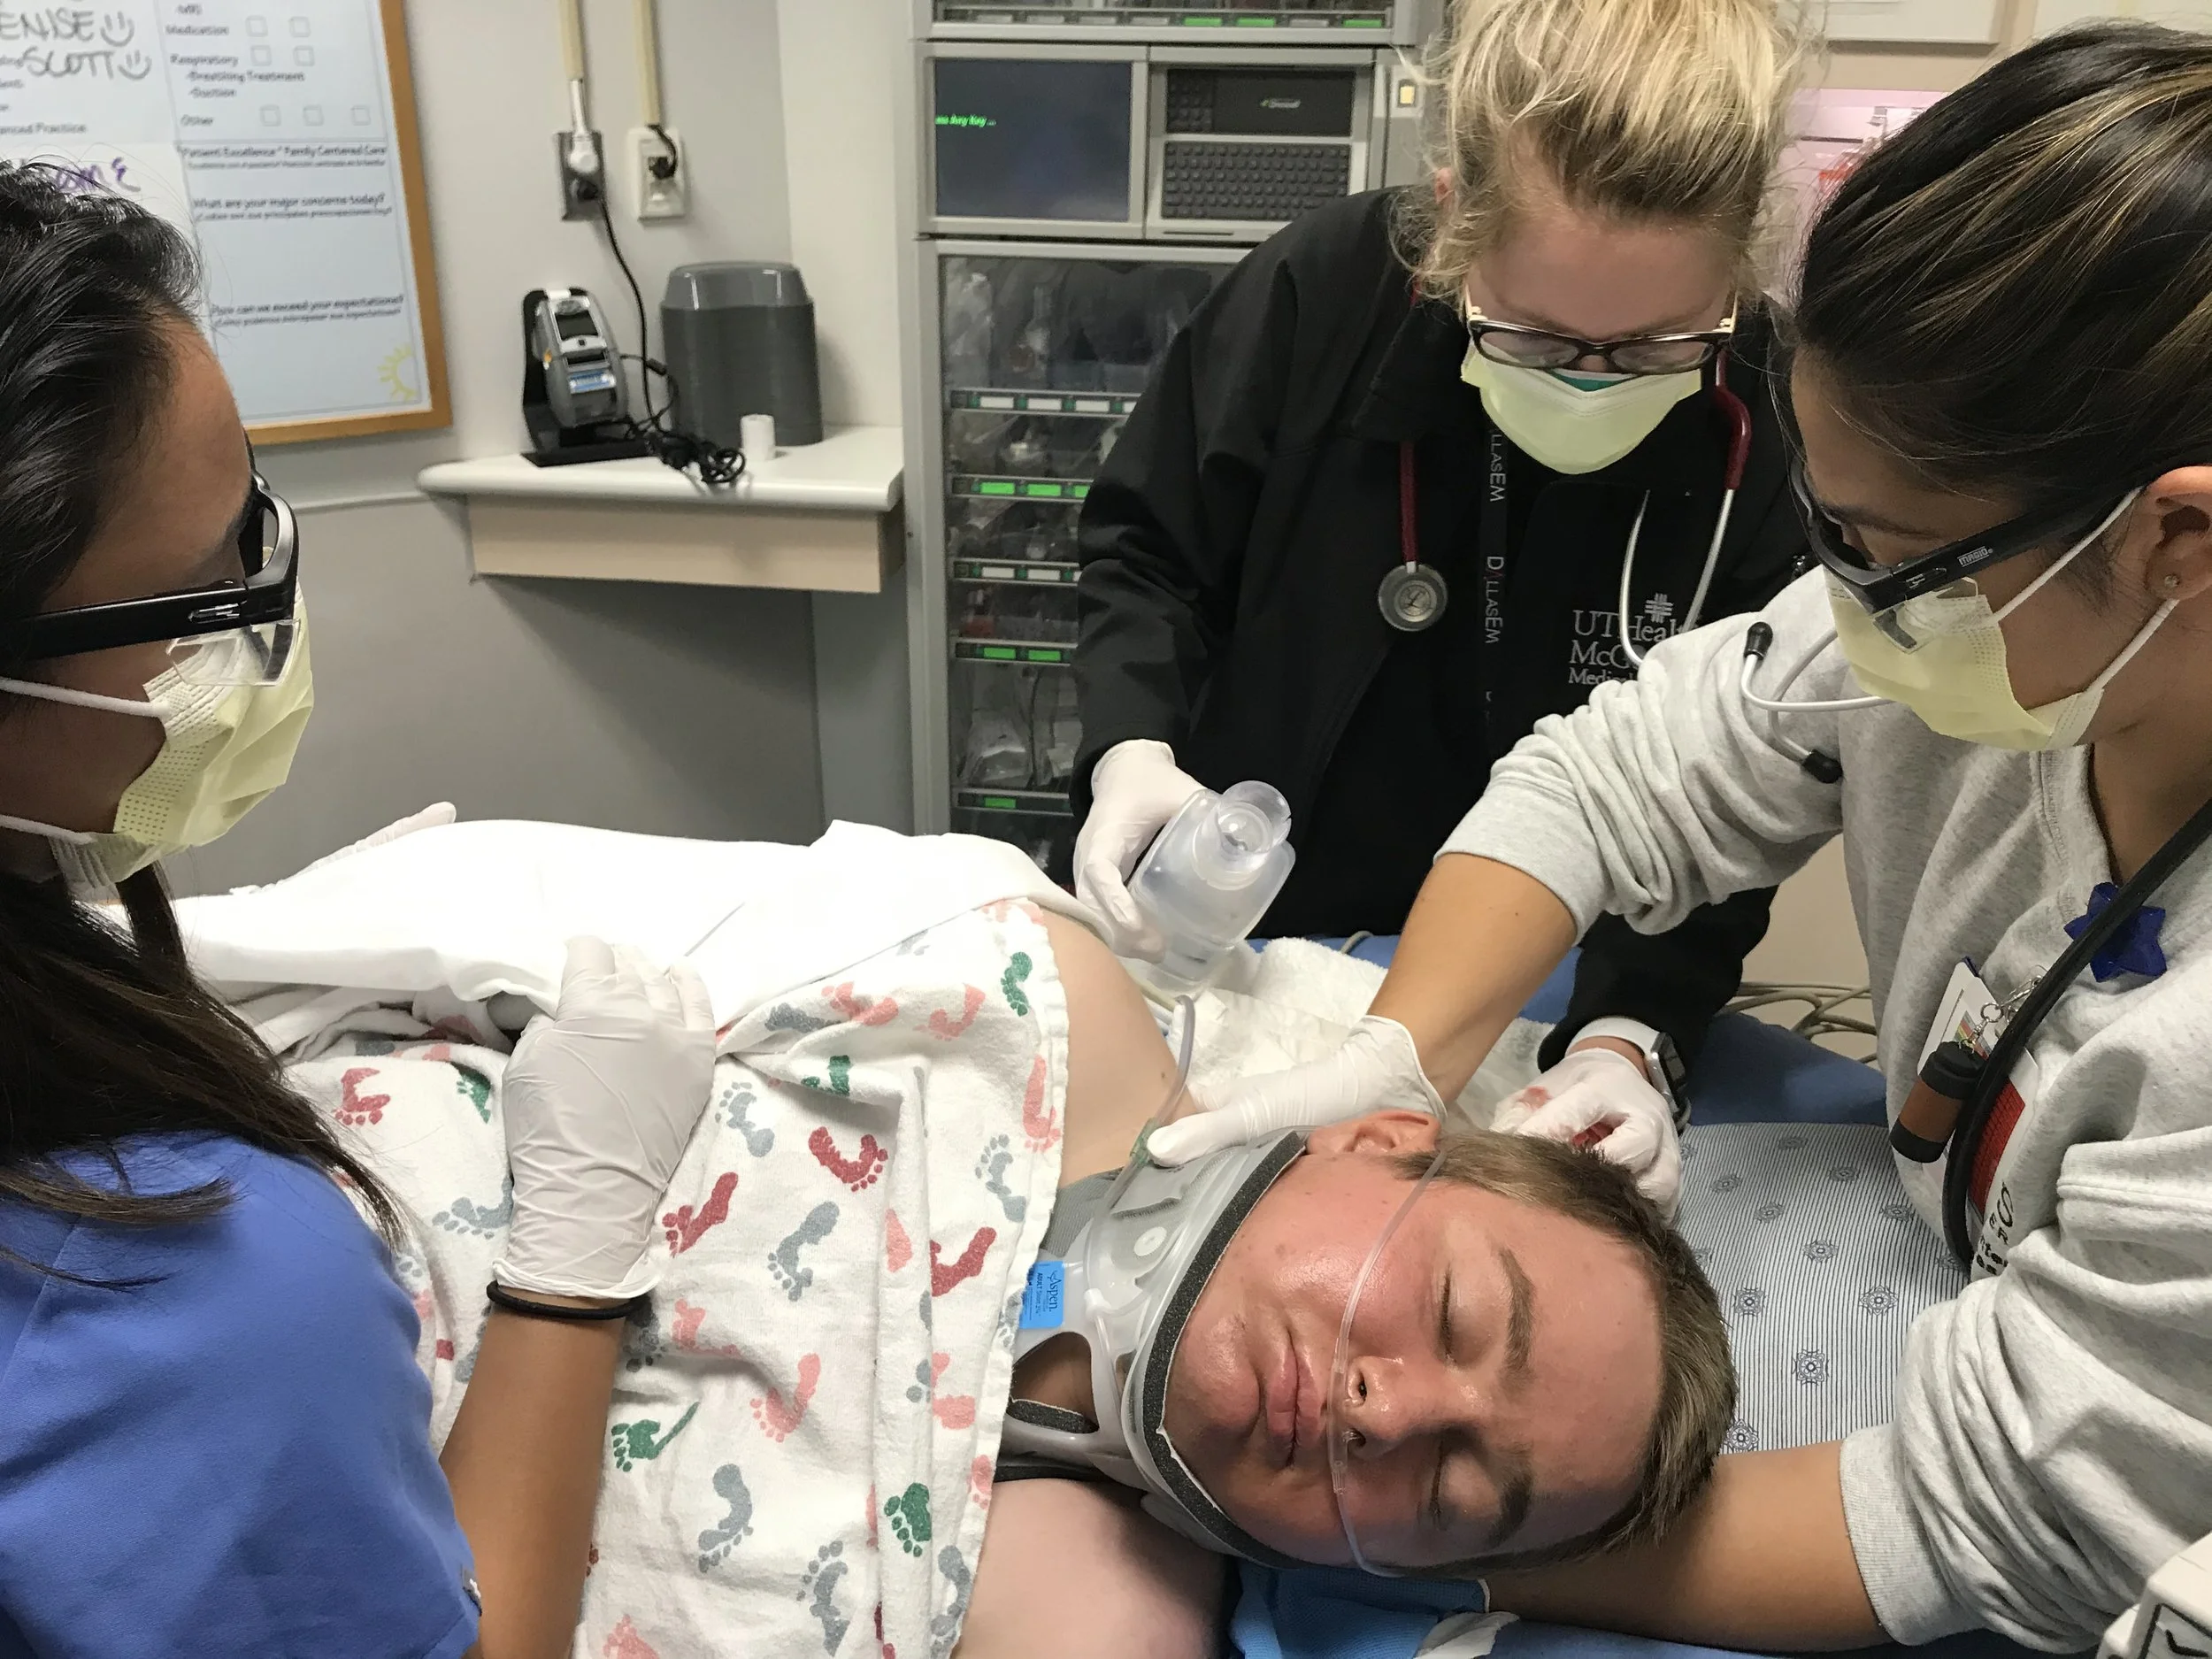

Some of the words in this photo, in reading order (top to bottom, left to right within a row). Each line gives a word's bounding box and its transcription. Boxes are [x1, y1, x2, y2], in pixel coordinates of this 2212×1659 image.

[165, 25, 229, 35] Medication
[22, 46, 115, 80] SCOTT
[170, 53, 239, 67] Respiratory
[246, 70, 305, 81] Treatment
[180, 114, 214, 127] Other
[35, 122, 87, 134] Practice
[193, 197, 221, 209] What
[225, 199, 242, 209] are
[243, 199, 267, 211] your
[269, 197, 298, 211] major
[301, 196, 347, 207] concerns
[349, 192, 385, 209] today?
[236, 305, 257, 315] can
[257, 304, 271, 313] we
[273, 300, 308, 312] exceed
